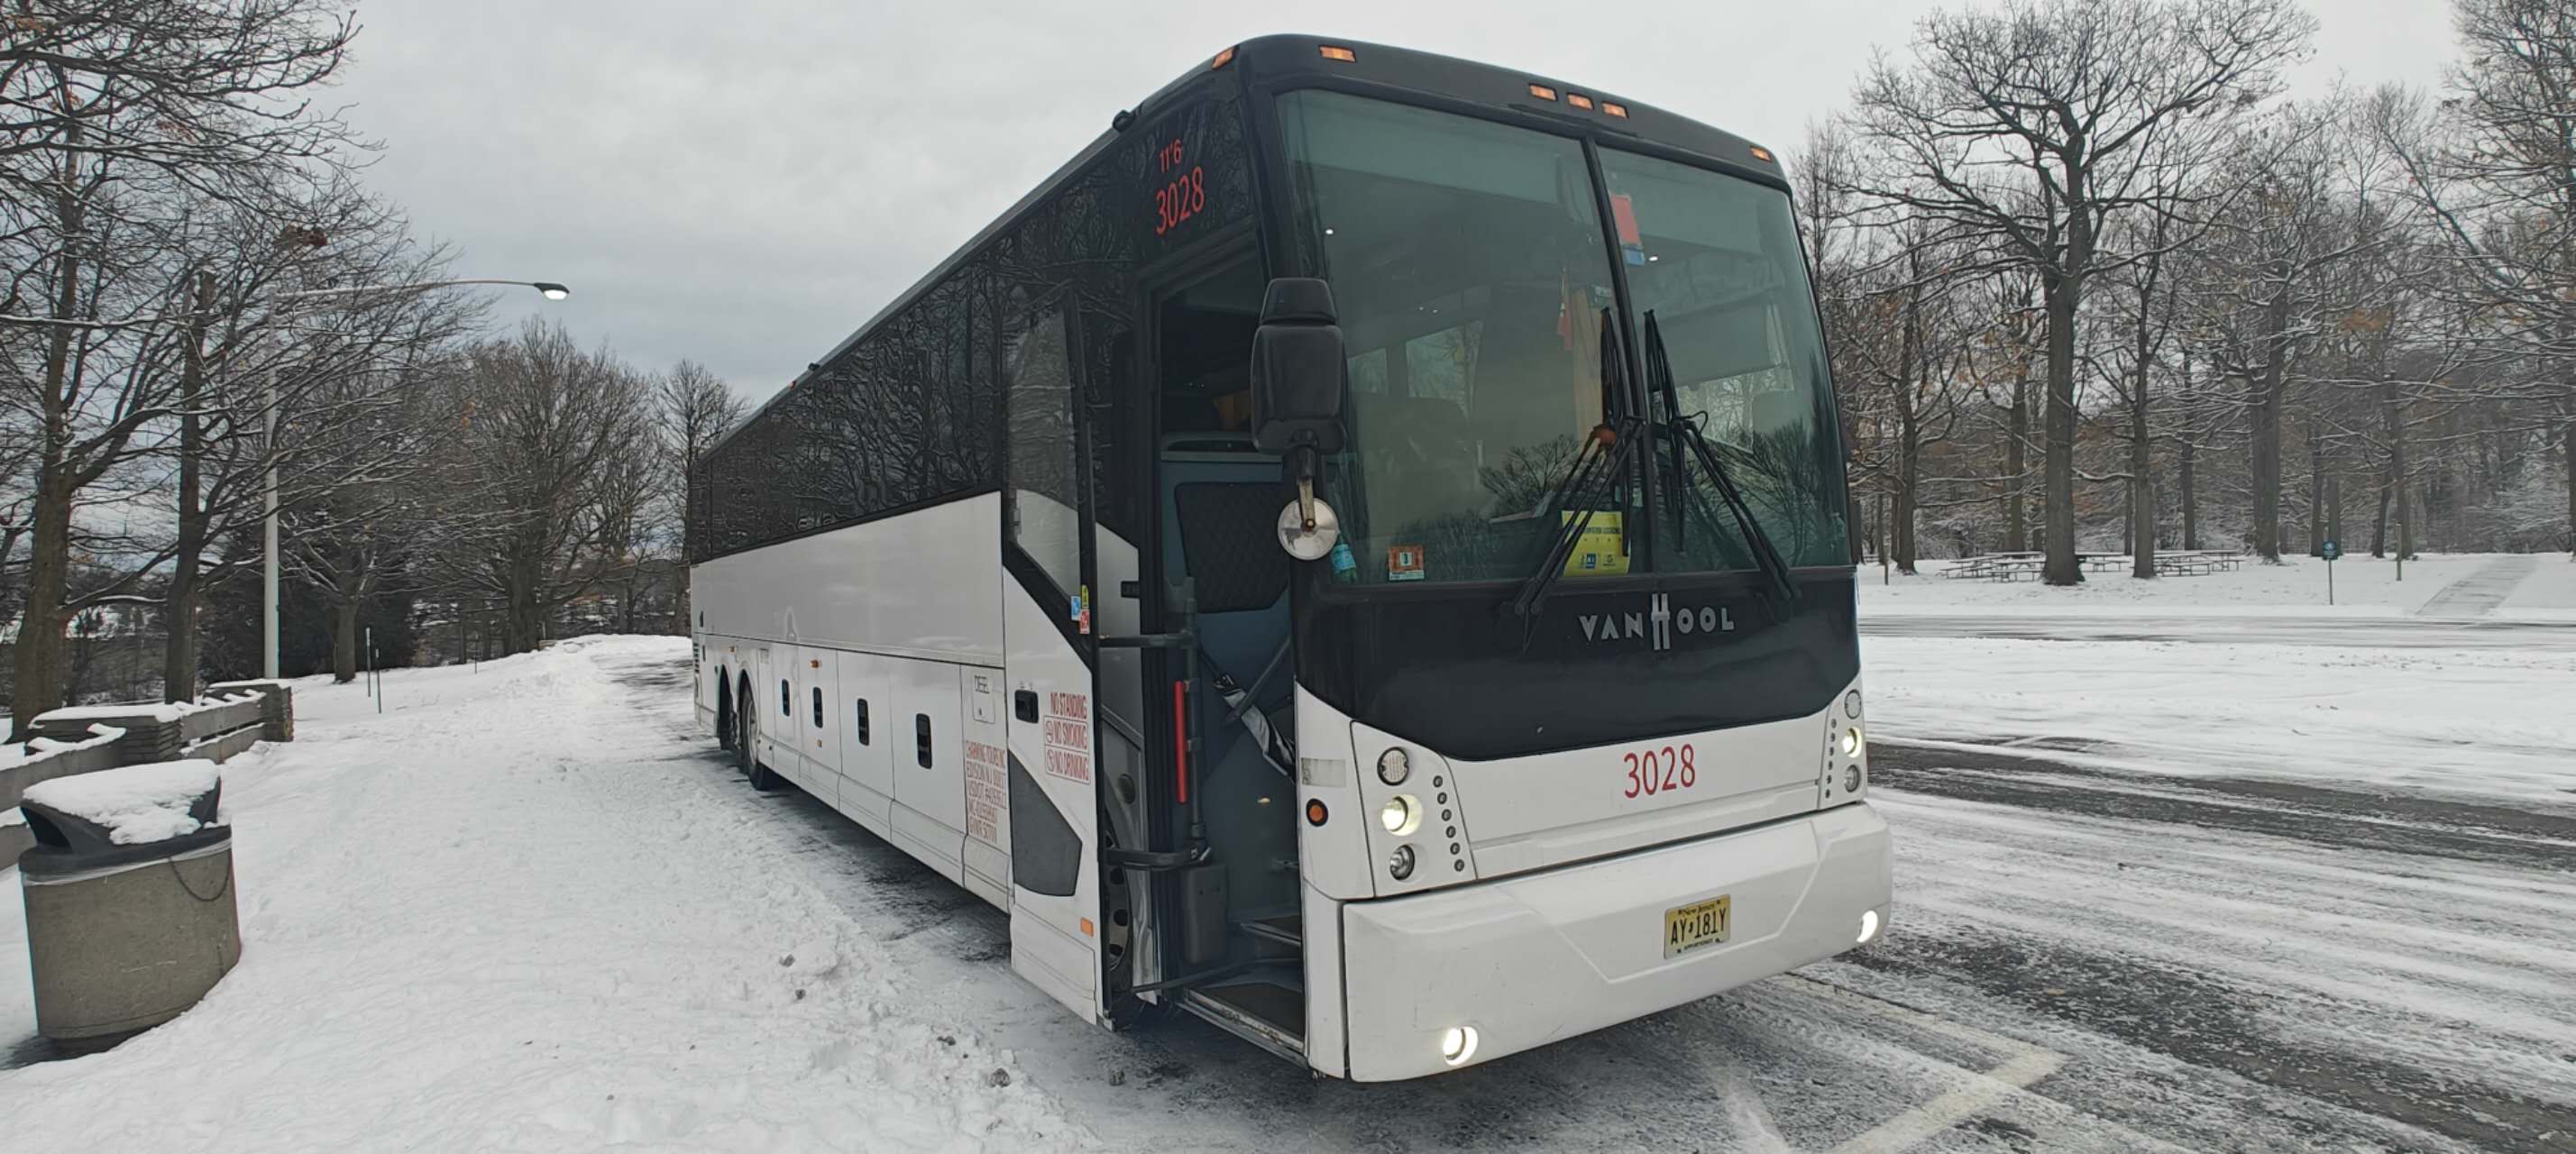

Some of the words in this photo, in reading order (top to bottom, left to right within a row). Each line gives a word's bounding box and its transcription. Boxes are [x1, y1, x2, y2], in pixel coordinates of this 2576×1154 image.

[1156, 166, 1205, 235] 3028
[1050, 692, 1059, 714] NO
[1059, 692, 1087, 719] STANDING
[1053, 720, 1061, 744] NO
[1062, 722, 1087, 750] SMOKING
[1054, 749, 1063, 774] NO
[1064, 752, 1089, 781] DRINKING
[1624, 744, 1696, 799] 3028
